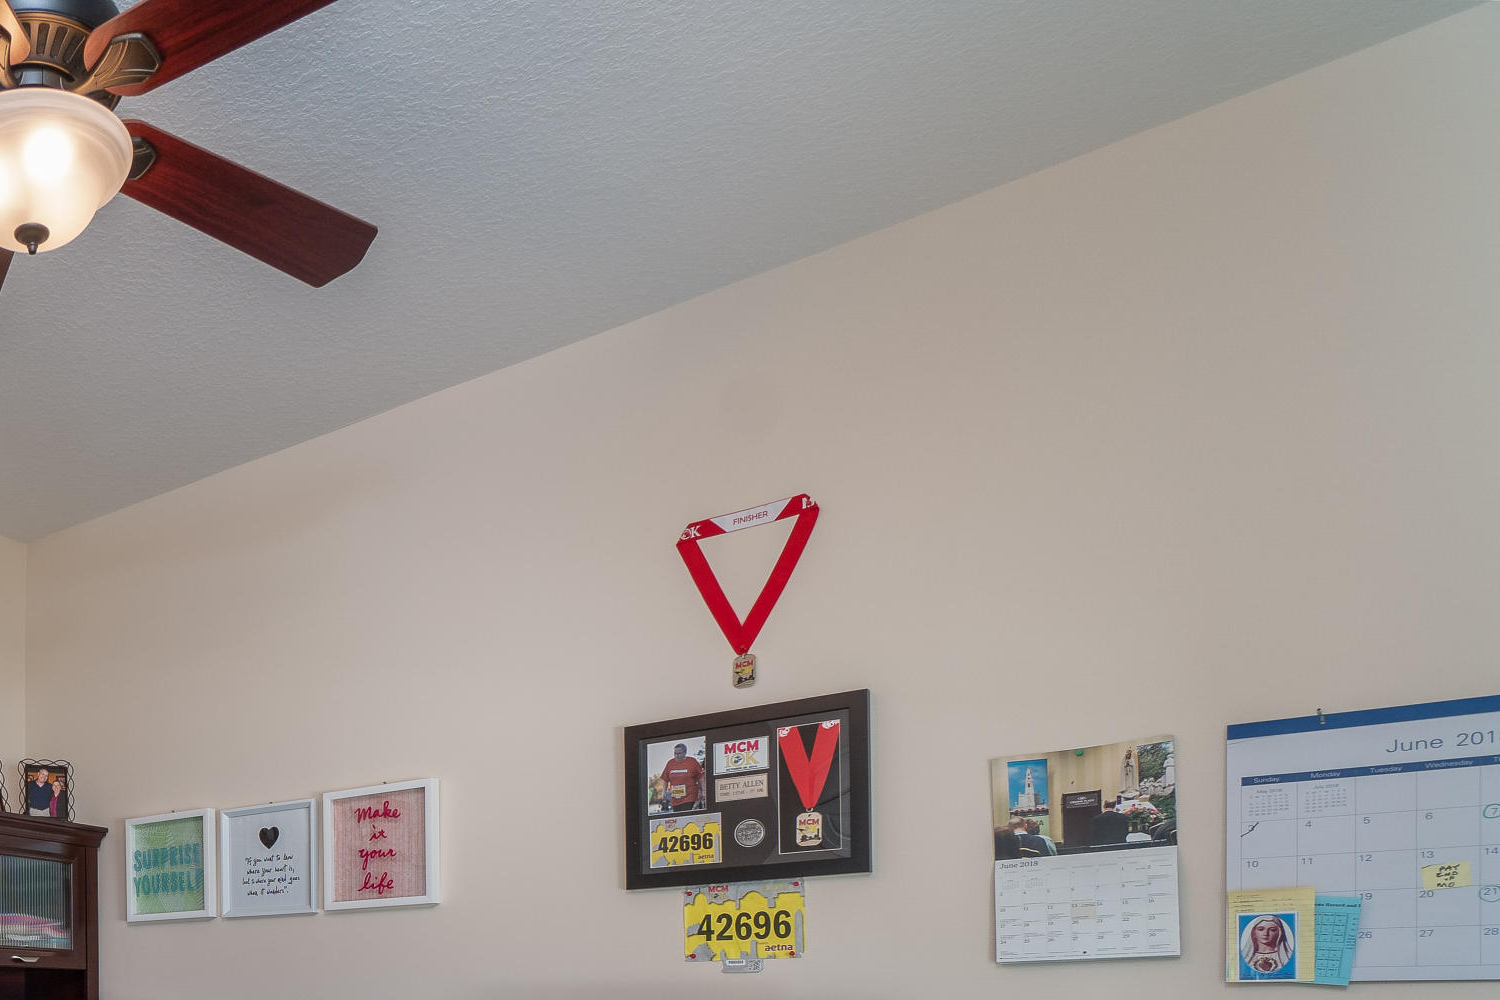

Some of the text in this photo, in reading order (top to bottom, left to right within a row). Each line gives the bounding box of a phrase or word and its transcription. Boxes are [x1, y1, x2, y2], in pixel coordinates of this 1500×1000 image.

[732, 511, 768, 526] FINISHER
[724, 740, 759, 754] MCM
[1386, 729, 1500, 753] June 201
[725, 751, 759, 768] 10K
[1253, 759, 1474, 785] Sunday Monday Tuesday Wednesday
[720, 779, 764, 791] BETTY ALLEN
[354, 800, 401, 823] Make
[1305, 820, 1312, 828] 4
[1363, 817, 1371, 825] 5
[1425, 812, 1433, 821] 6
[1491, 808, 1498, 816] 7
[799, 818, 820, 826] MCM
[368, 824, 387, 841] it
[658, 832, 714, 853] 42696
[133, 842, 200, 872] SURPRISE
[358, 848, 397, 871] your
[1246, 847, 1499, 868] 10 11 12 13 14
[133, 868, 204, 898] YOURSELF
[356, 872, 394, 895] life
[708, 885, 729, 893] MCM
[1359, 892, 1372, 901] 19
[1420, 890, 1434, 898] 20
[697, 910, 792, 942] 42696
[1358, 928, 1499, 939] 26 27 28
[764, 944, 793, 952] aetna
